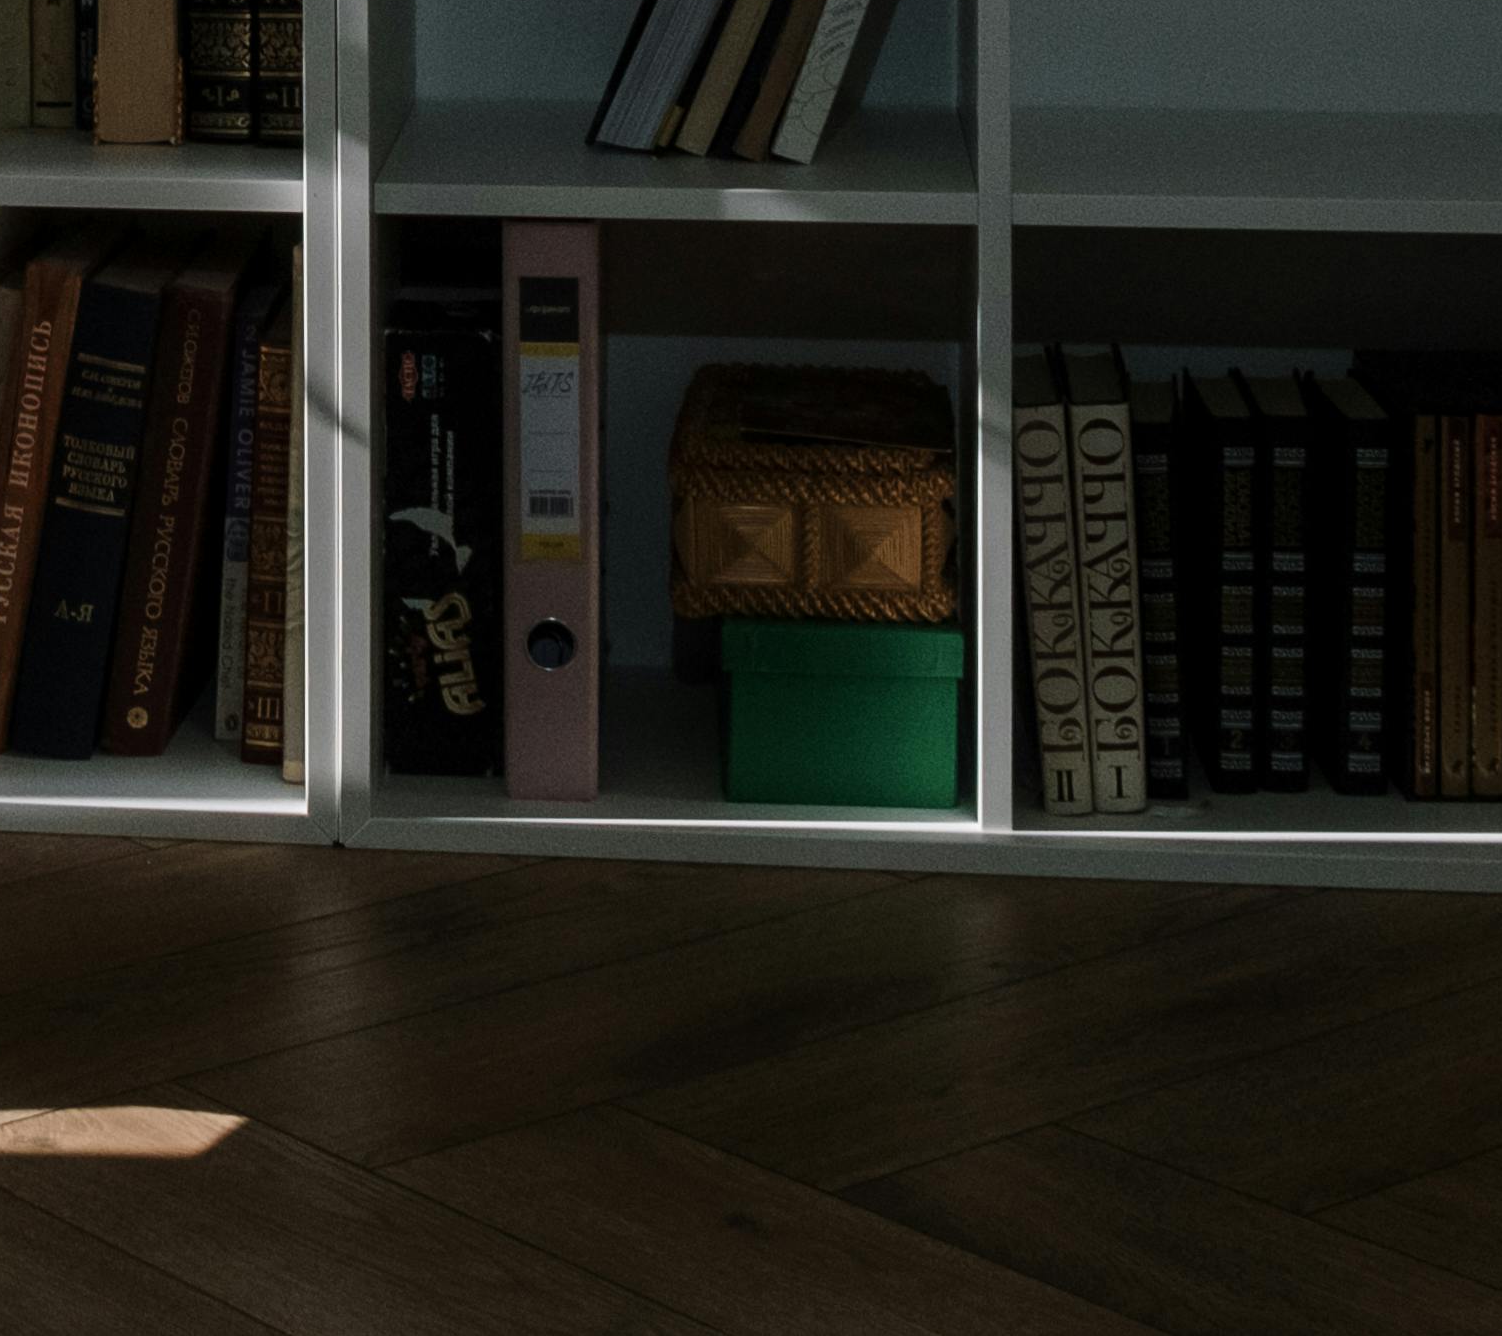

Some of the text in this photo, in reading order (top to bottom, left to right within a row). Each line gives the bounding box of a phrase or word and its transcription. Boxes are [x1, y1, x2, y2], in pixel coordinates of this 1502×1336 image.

[8, 319, 52, 489] ИКОНОПИСЬ
[237, 347, 258, 417] JAMIE
[62, 465, 128, 490] РУССКОГО
[63, 433, 137, 461] ТОЛКОВЫЙ
[67, 450, 127, 475] СЛОВАРЬ
[161, 416, 189, 507] СЛОВАРЬ
[233, 428, 255, 510] OLIVER
[68, 481, 115, 503] ЯЗЫКА
[144, 513, 178, 621] РУССКОГО
[1016, 419, 1088, 761] БОККАЧЧО
[1076, 418, 1145, 761] БОККАЧЧО
[132, 623, 160, 698] ЯЗЫКА
[257, 696, 281, 720] III
